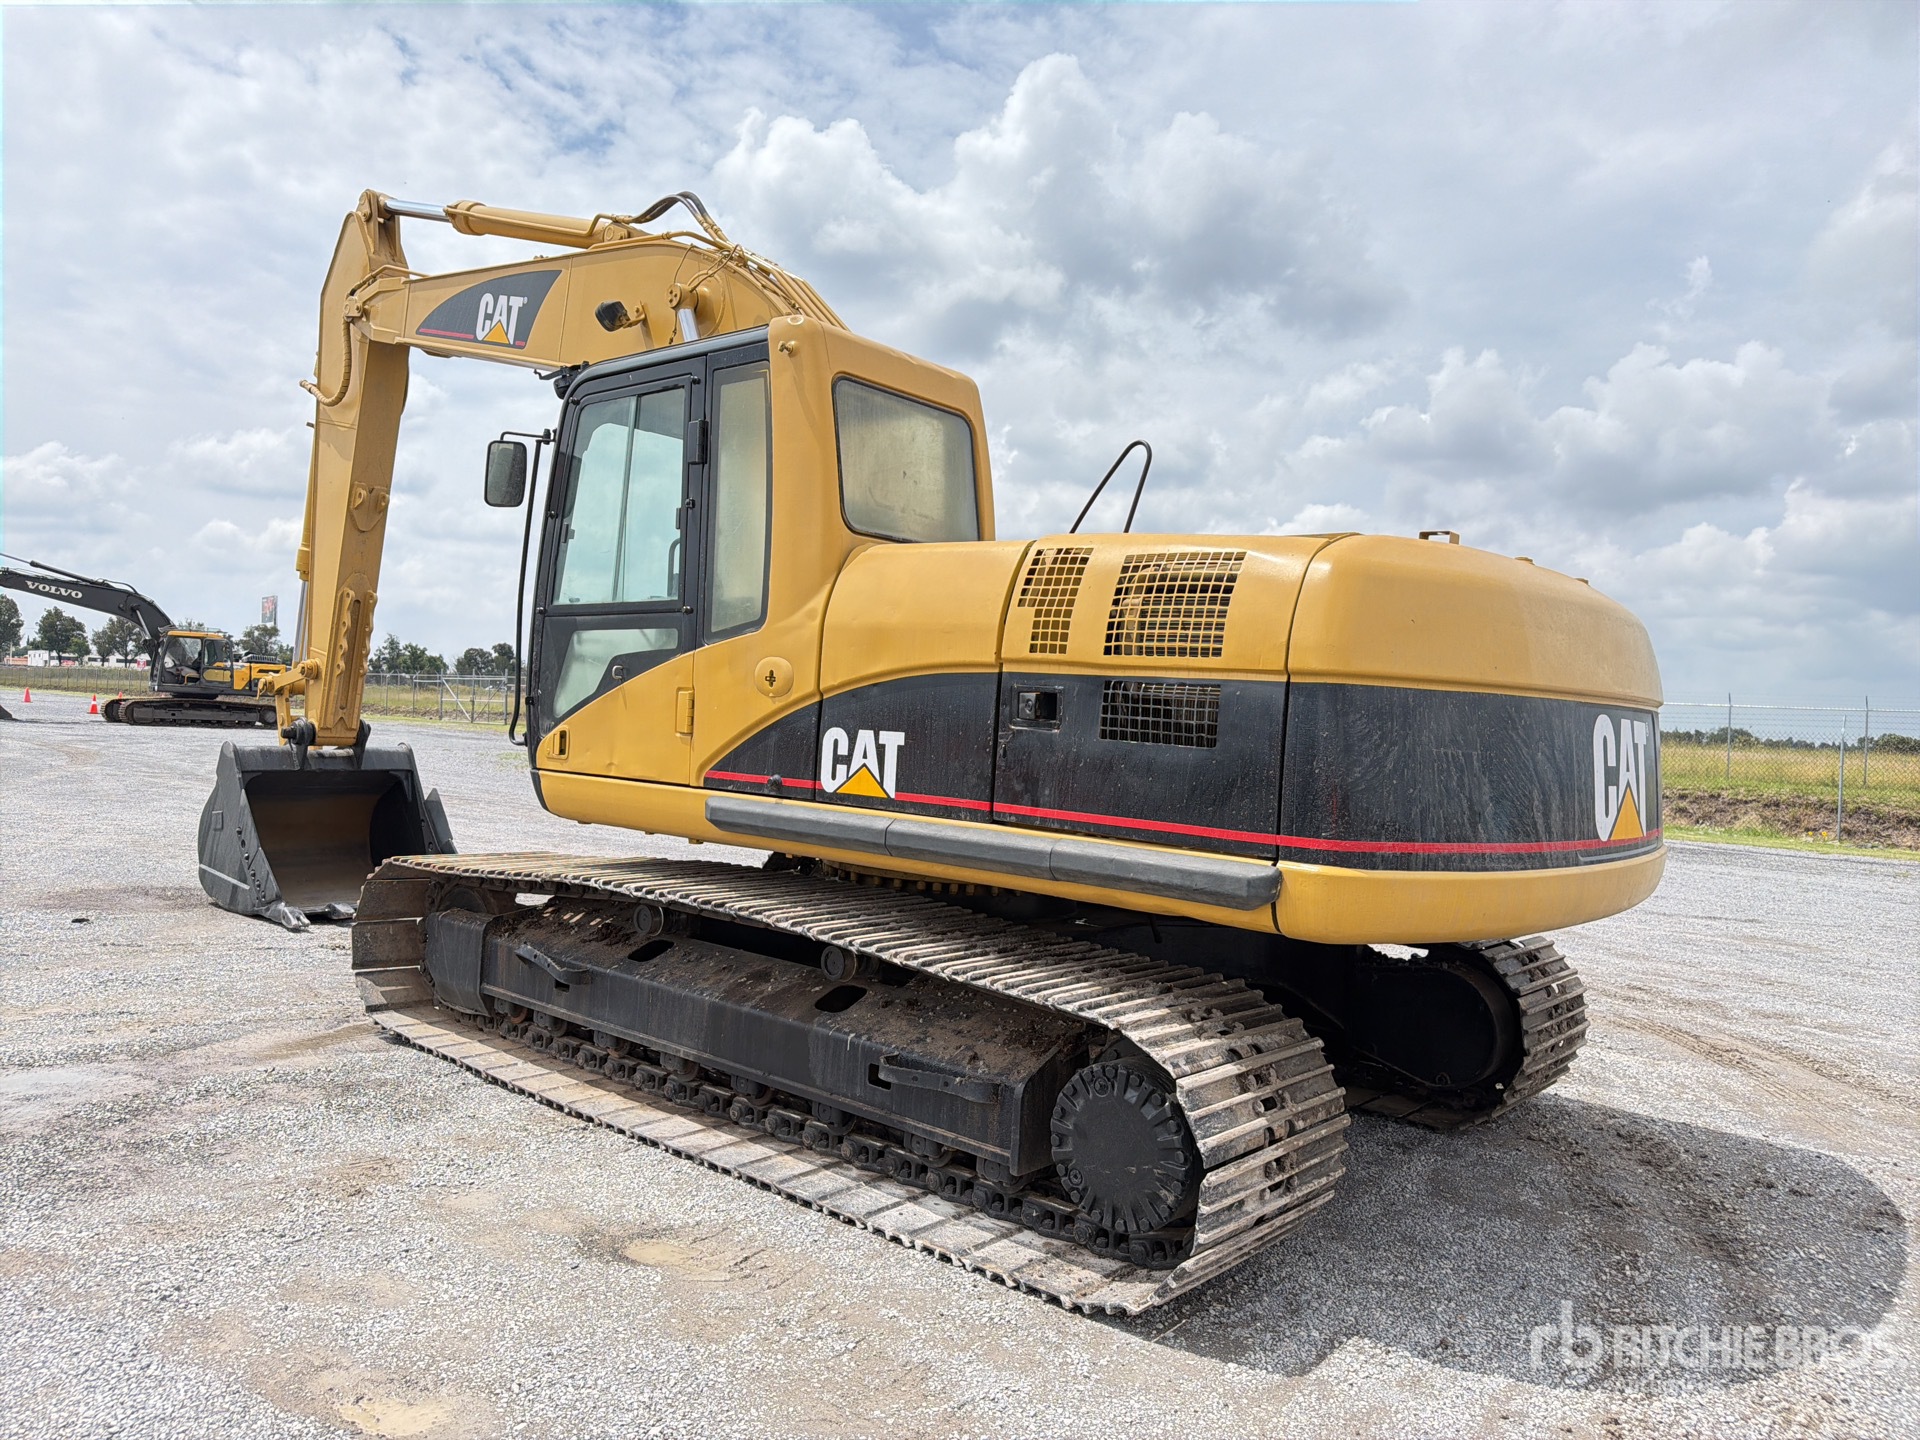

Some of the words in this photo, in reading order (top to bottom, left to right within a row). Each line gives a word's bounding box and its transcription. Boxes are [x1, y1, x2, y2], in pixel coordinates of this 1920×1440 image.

[475, 292, 525, 345] CAT
[25, 580, 83, 599] VOLVO
[820, 726, 906, 799] CAT
[1592, 713, 1647, 842] CAT
